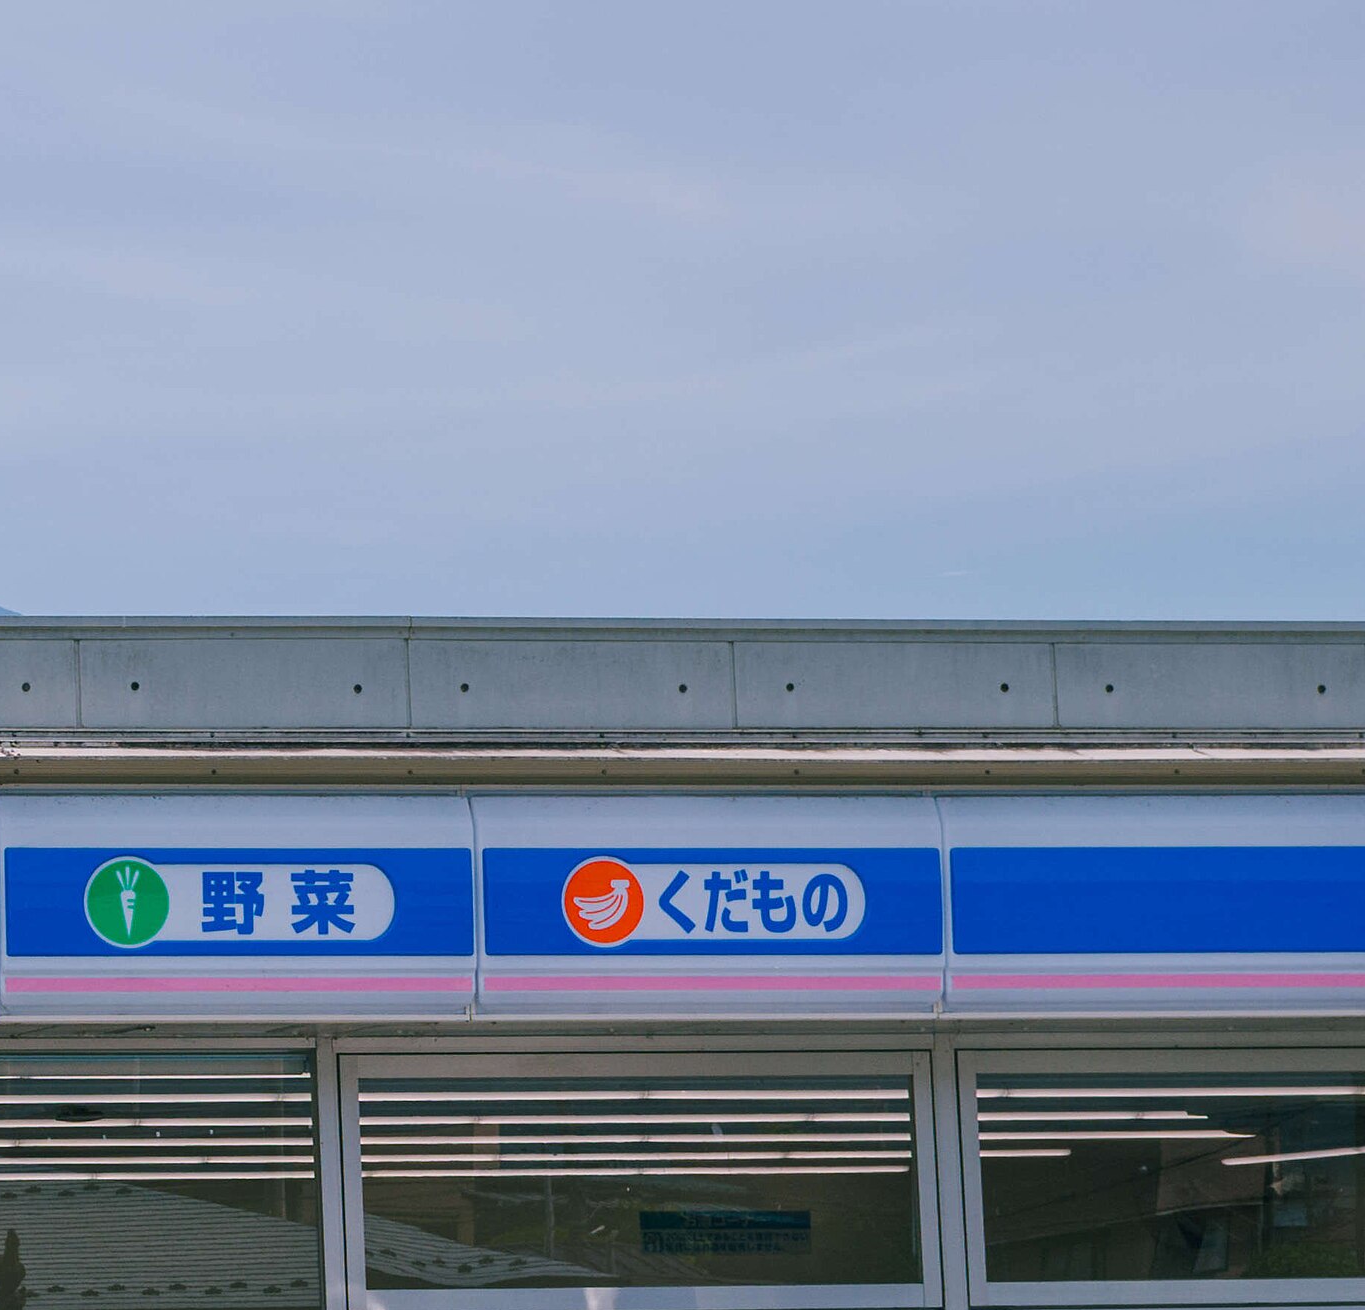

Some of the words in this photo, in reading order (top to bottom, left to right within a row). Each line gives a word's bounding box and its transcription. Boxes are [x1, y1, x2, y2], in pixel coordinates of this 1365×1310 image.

[201, 869, 357, 936] 野菜
[657, 869, 849, 935] くだもの
